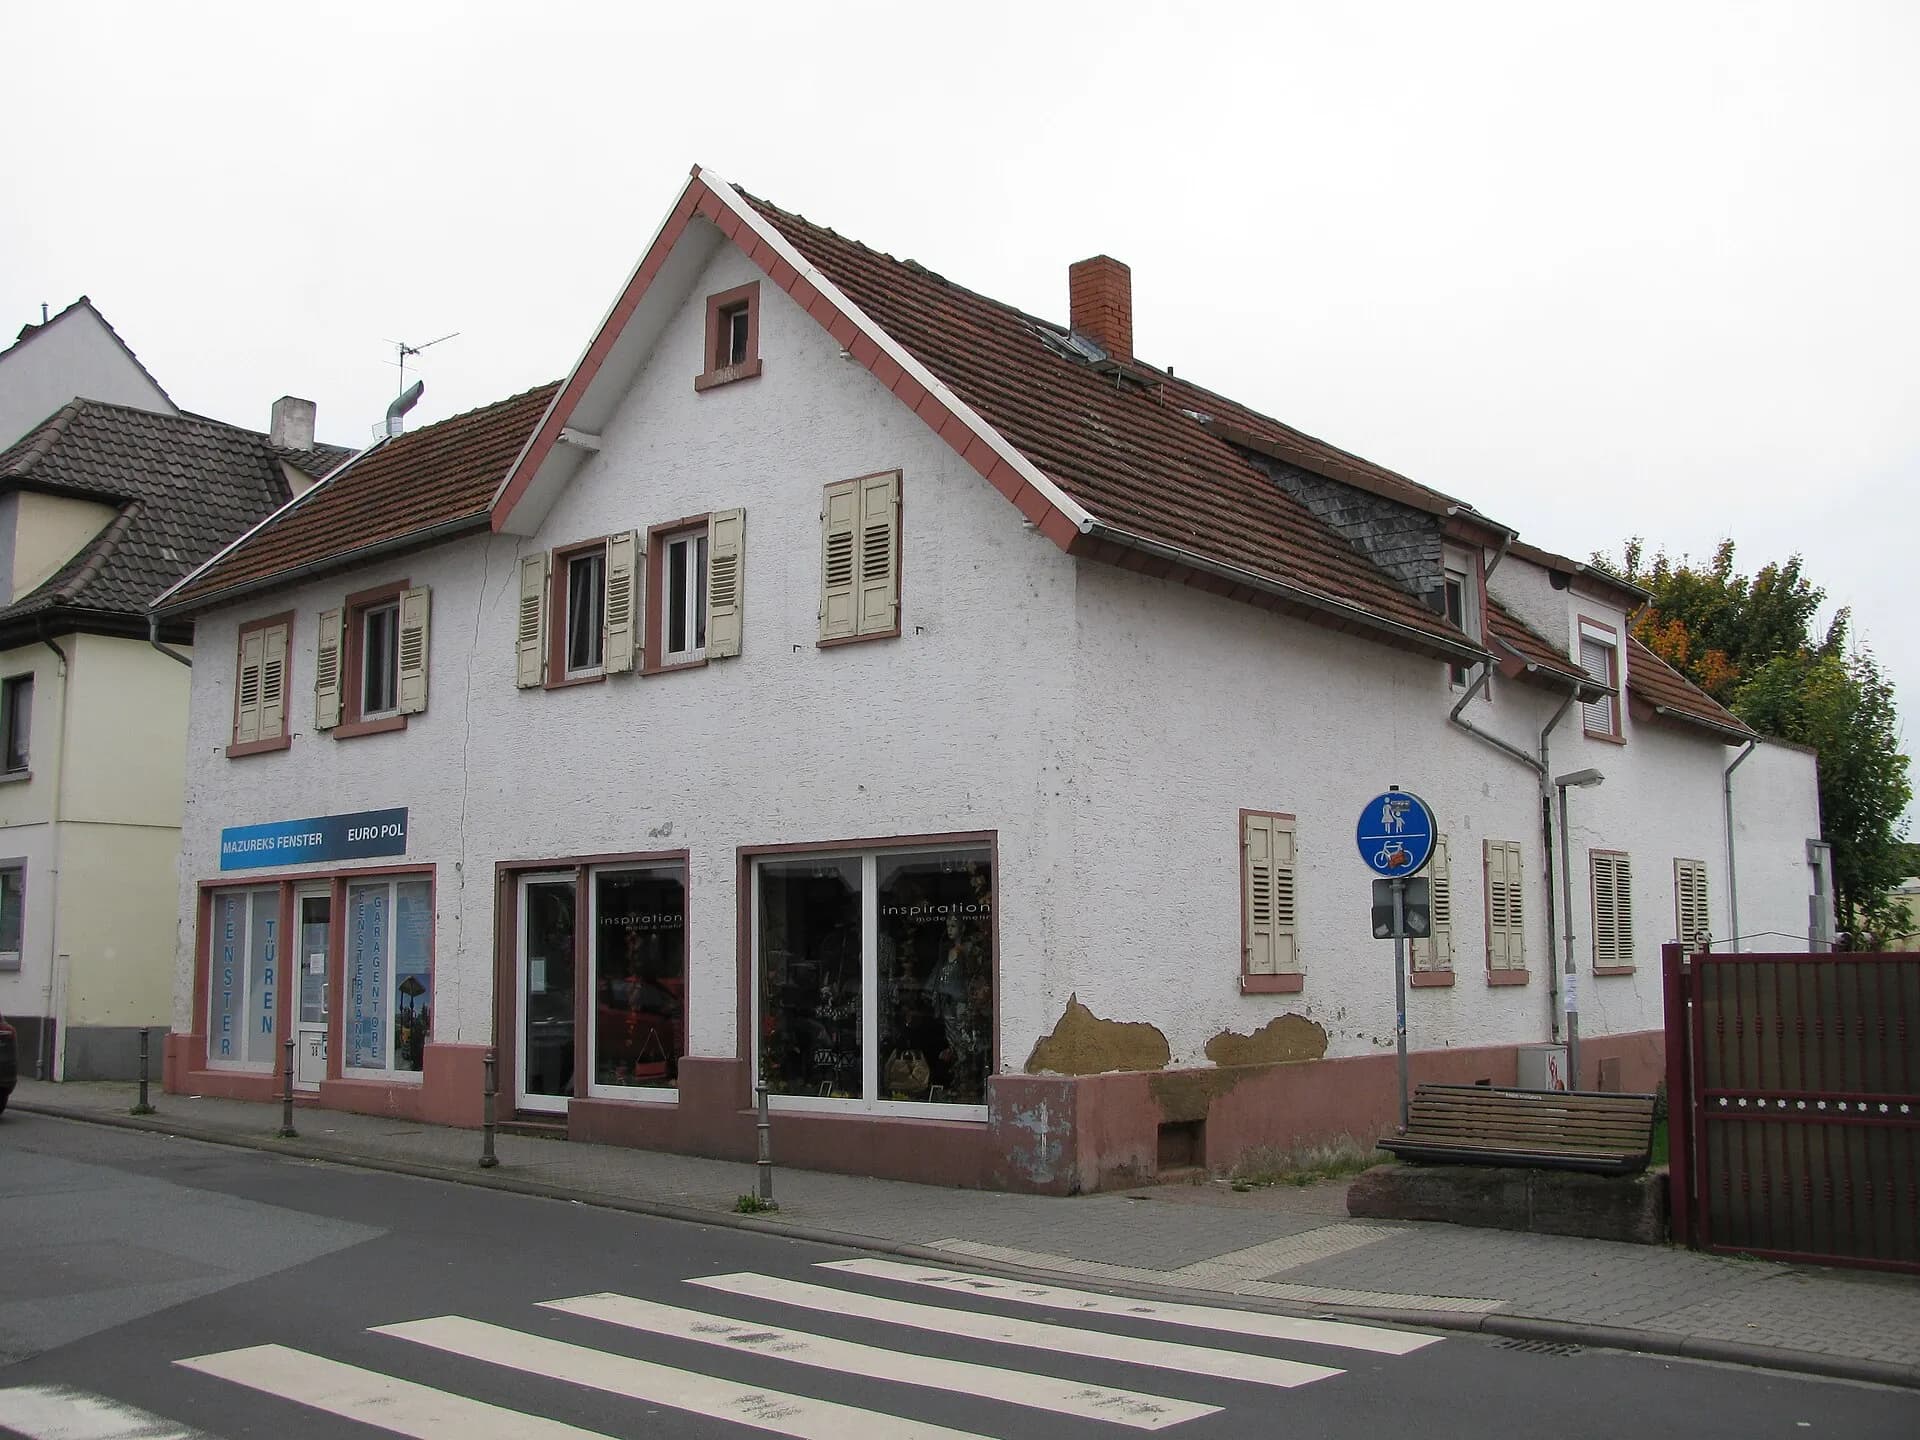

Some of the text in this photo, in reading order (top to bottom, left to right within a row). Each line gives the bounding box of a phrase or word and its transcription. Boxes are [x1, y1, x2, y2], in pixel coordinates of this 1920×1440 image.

[347, 823, 405, 842] EURO POL
[223, 832, 323, 854] MAZUREKS FENSTER
[600, 913, 683, 926] inspiration
[882, 902, 991, 917] inspiration
[221, 899, 235, 1056] FENSTER
[262, 920, 275, 1034] TÜREN
